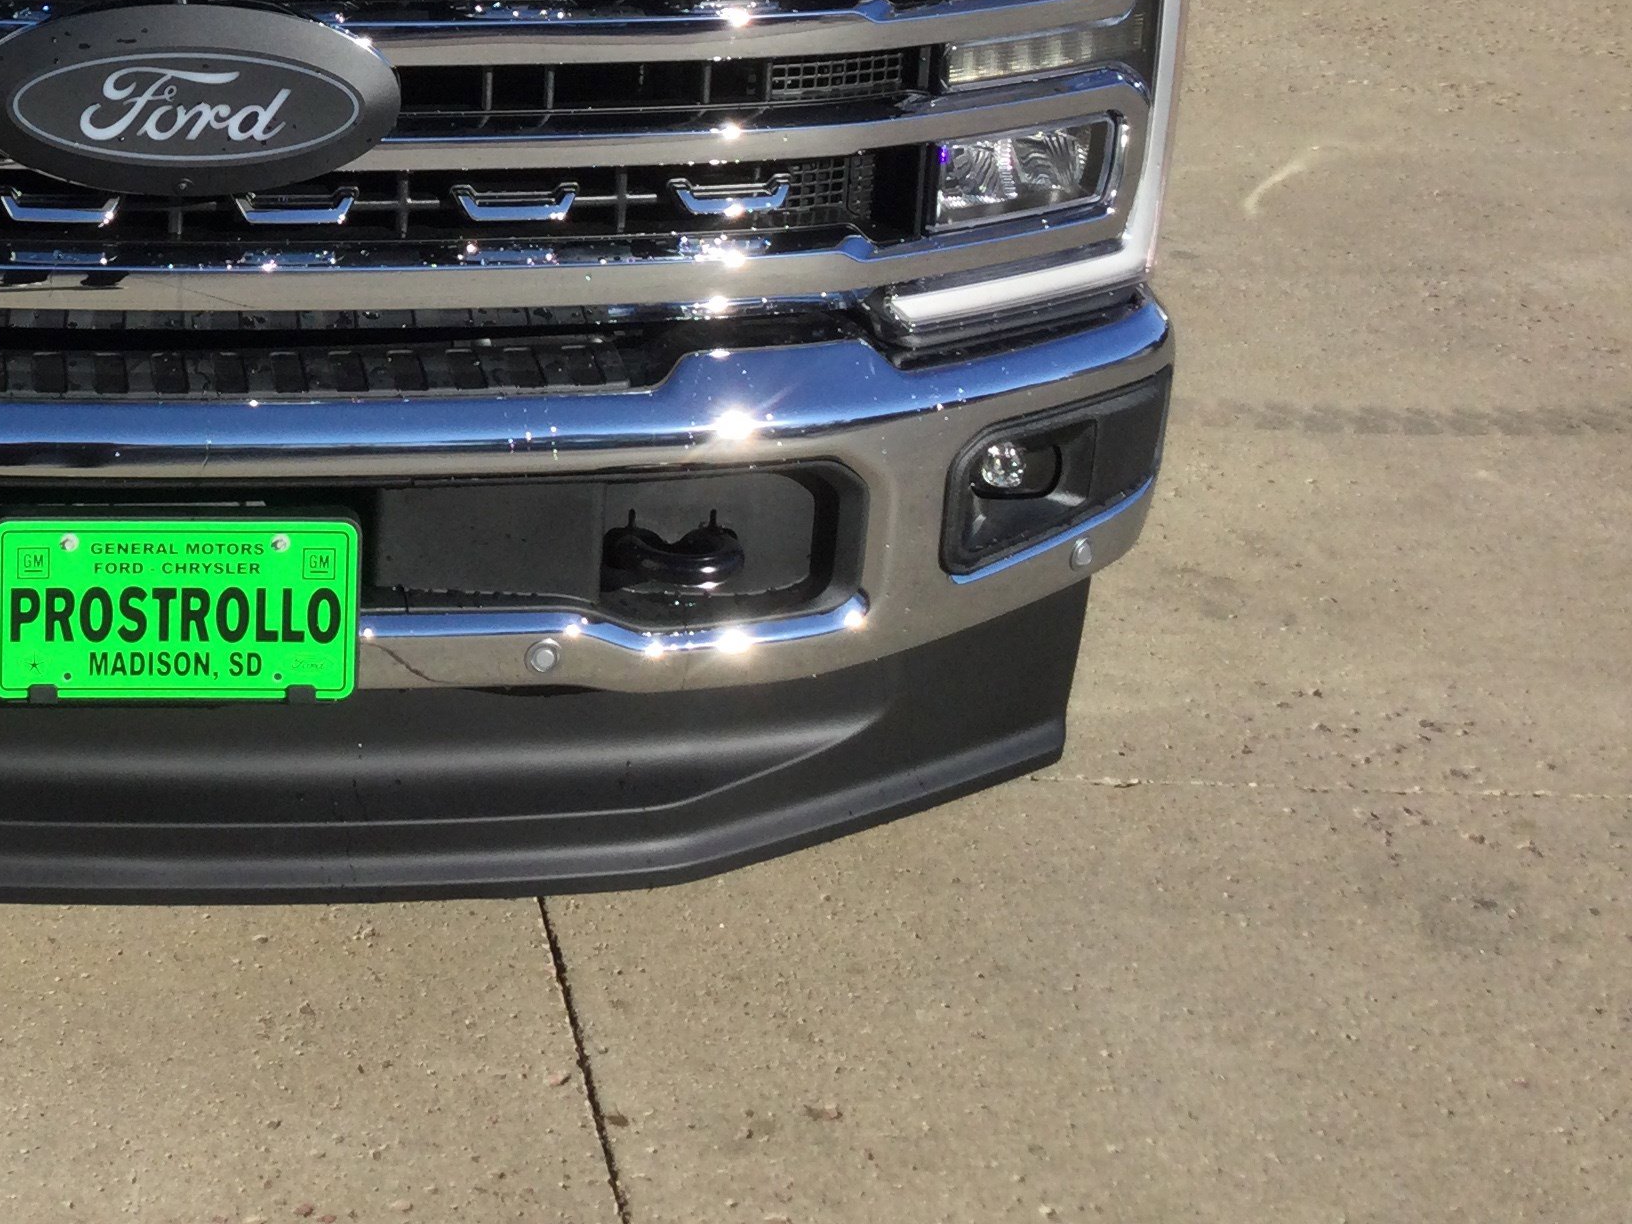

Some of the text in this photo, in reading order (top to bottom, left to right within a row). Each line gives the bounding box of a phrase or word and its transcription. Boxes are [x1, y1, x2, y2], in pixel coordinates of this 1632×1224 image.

[79, 66, 292, 142] Ford
[90, 542, 265, 556] GENERAL MOTORS
[93, 562, 144, 575] FORD
[161, 562, 261, 575] CHRYSLER
[9, 586, 342, 645] PROSTROLLO
[88, 652, 263, 680] MADISON, SD
